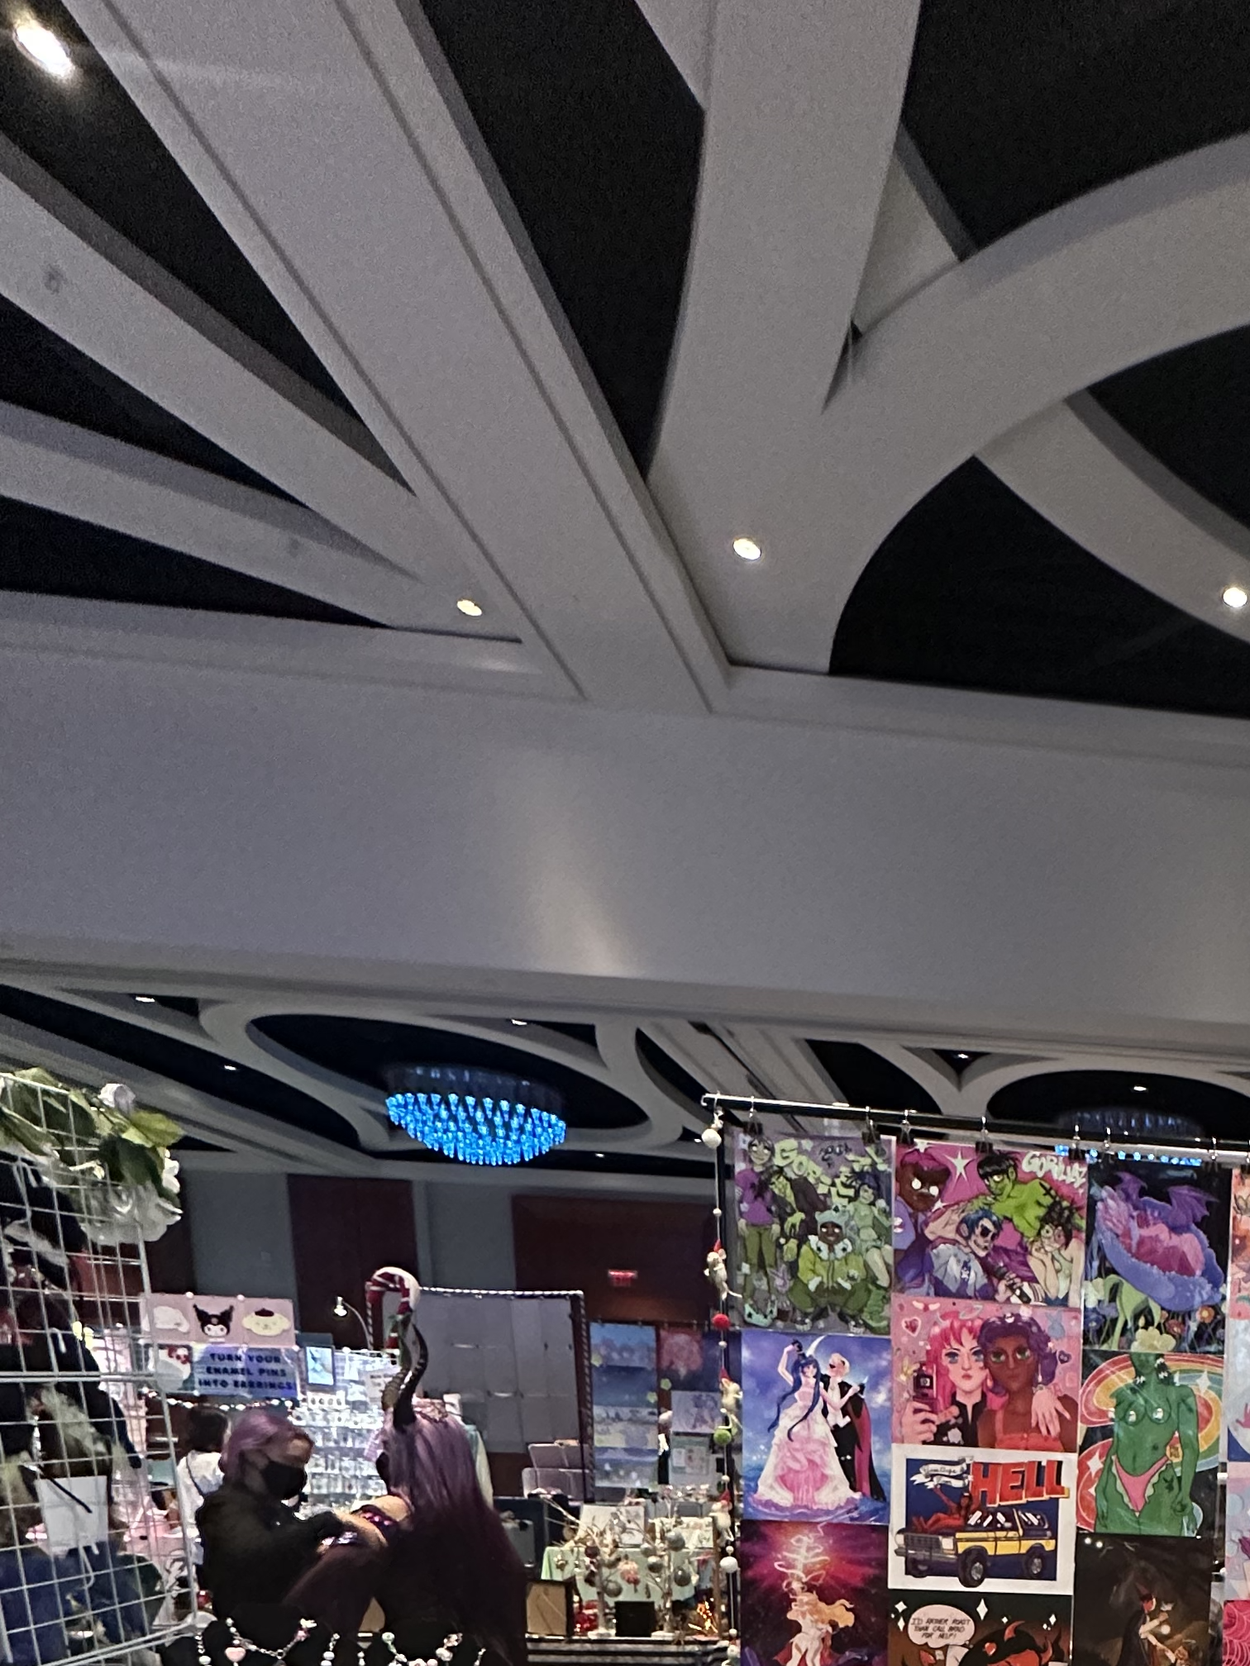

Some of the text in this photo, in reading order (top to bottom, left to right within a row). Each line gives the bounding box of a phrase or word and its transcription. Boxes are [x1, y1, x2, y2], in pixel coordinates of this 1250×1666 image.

[209, 1353, 281, 1364] TURN YOUR
[206, 1367, 287, 1378] ENAMEL PINS
[198, 1379, 229, 1388] INTO
[969, 1459, 1070, 1507] HELL
